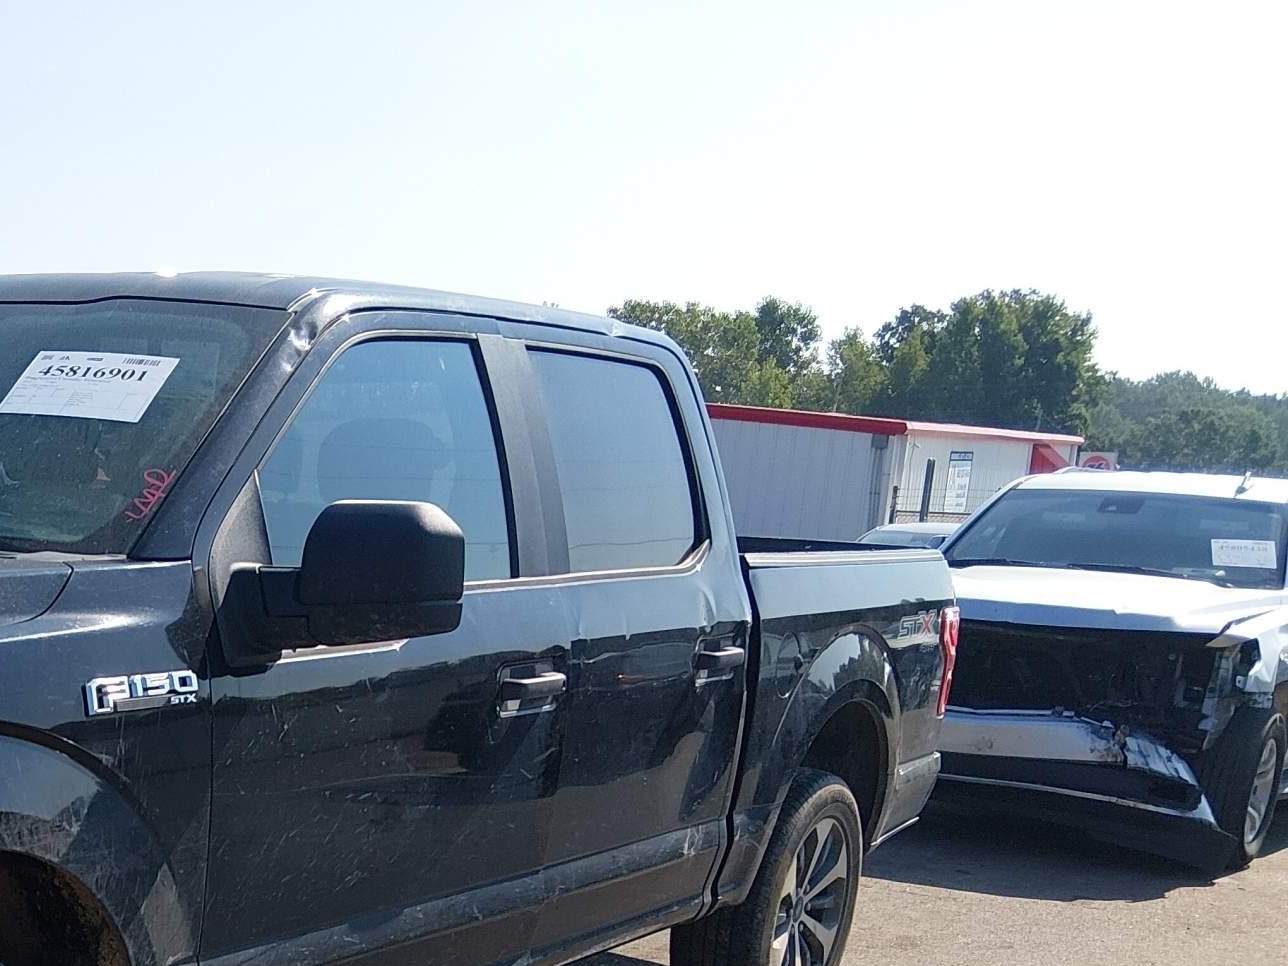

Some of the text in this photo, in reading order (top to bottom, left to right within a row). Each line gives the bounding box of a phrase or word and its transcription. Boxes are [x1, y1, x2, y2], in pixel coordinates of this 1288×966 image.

[38, 364, 148, 383] 45816901
[897, 609, 938, 640] STX
[170, 693, 197, 704] STX
